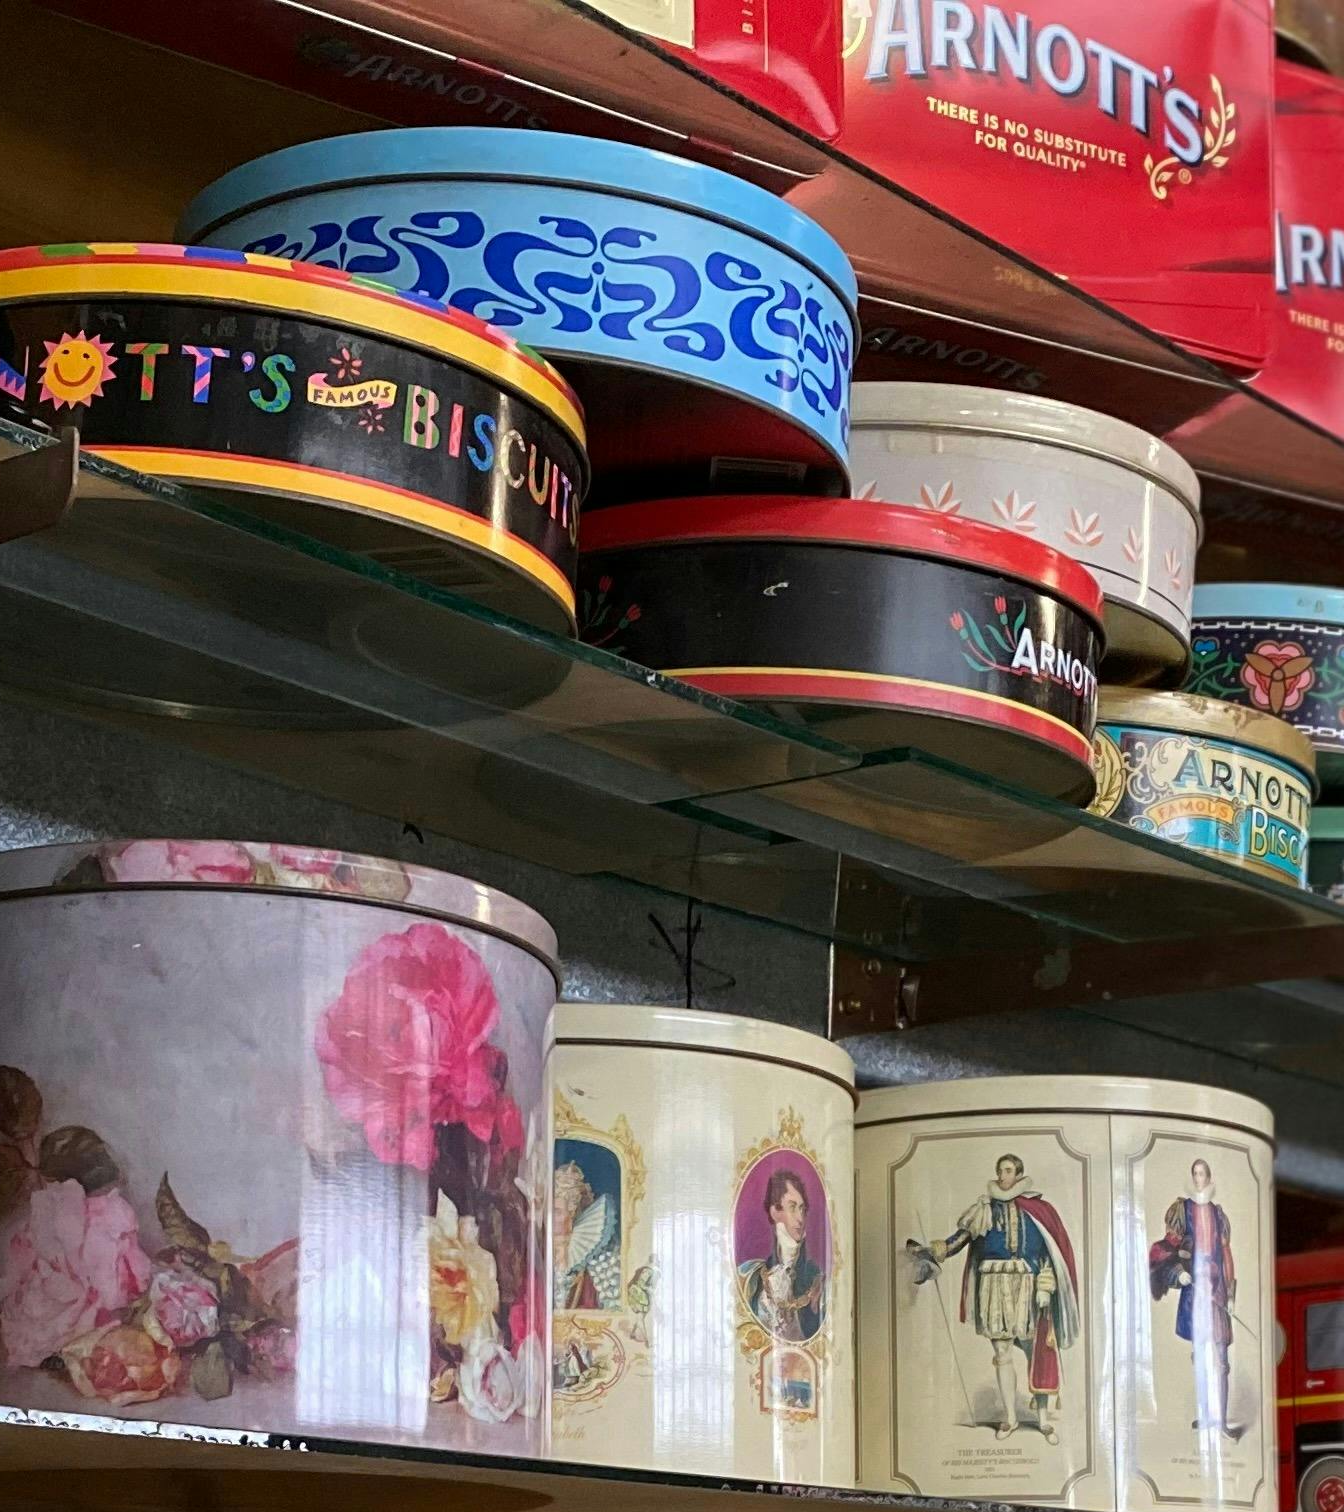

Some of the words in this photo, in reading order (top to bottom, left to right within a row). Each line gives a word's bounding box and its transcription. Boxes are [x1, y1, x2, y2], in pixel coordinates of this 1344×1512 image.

[864, 0, 1204, 166] ARNOTT'S
[926, 96, 978, 125] THERE
[984, 112, 1000, 130] IS
[1004, 118, 1029, 138] NO
[1033, 127, 1127, 168] SUBSTITUTE
[975, 130, 1008, 152] FOR
[1289, 309, 1330, 332] THERE
[312, 385, 391, 404] FAMOUS
[403, 384, 581, 547] BISCUITS
[1156, 799, 1231, 823] FAMOUS
